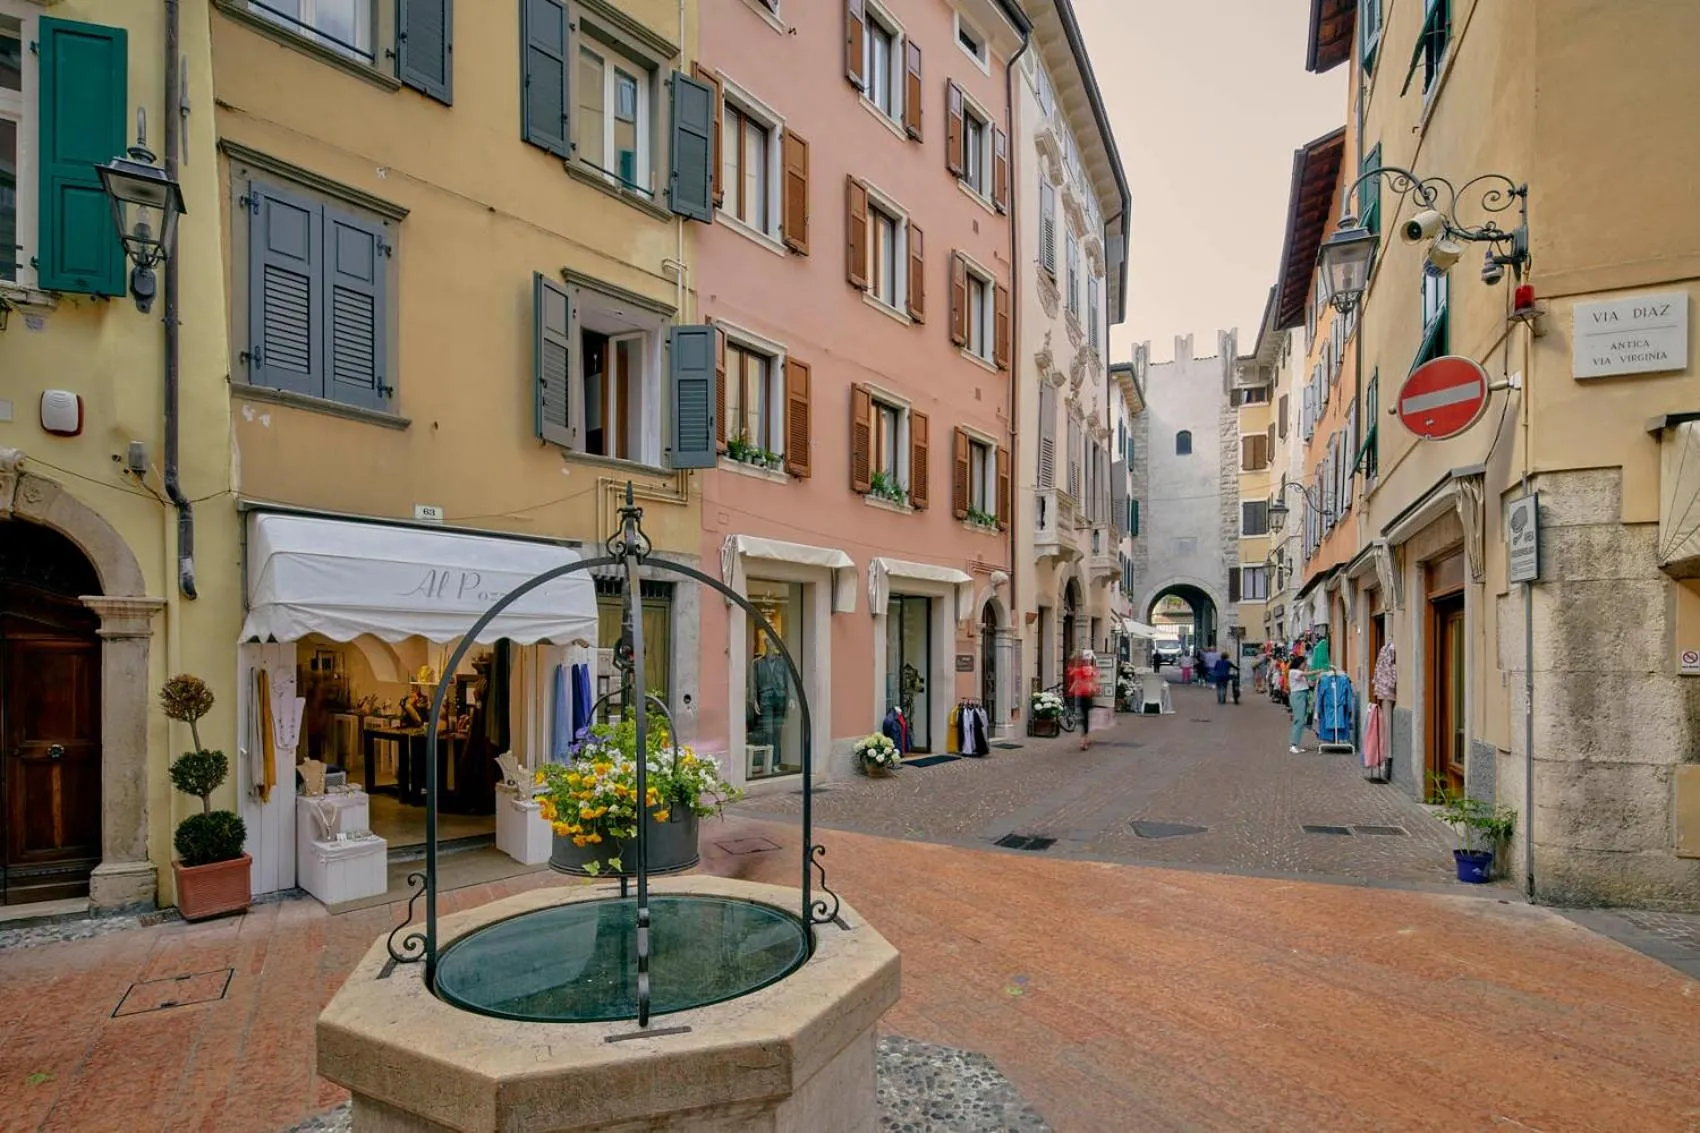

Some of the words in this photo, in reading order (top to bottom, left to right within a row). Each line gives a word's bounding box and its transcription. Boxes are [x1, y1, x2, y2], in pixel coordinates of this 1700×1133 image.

[1593, 311, 1619, 323] VIA
[1633, 304, 1671, 319] DIAZ
[1610, 340, 1650, 351] ANTICA
[1593, 357, 1612, 366] VIA
[1620, 351, 1668, 363] VIRGINIA
[423, 507, 435, 517] 63
[396, 568, 449, 598] Al
